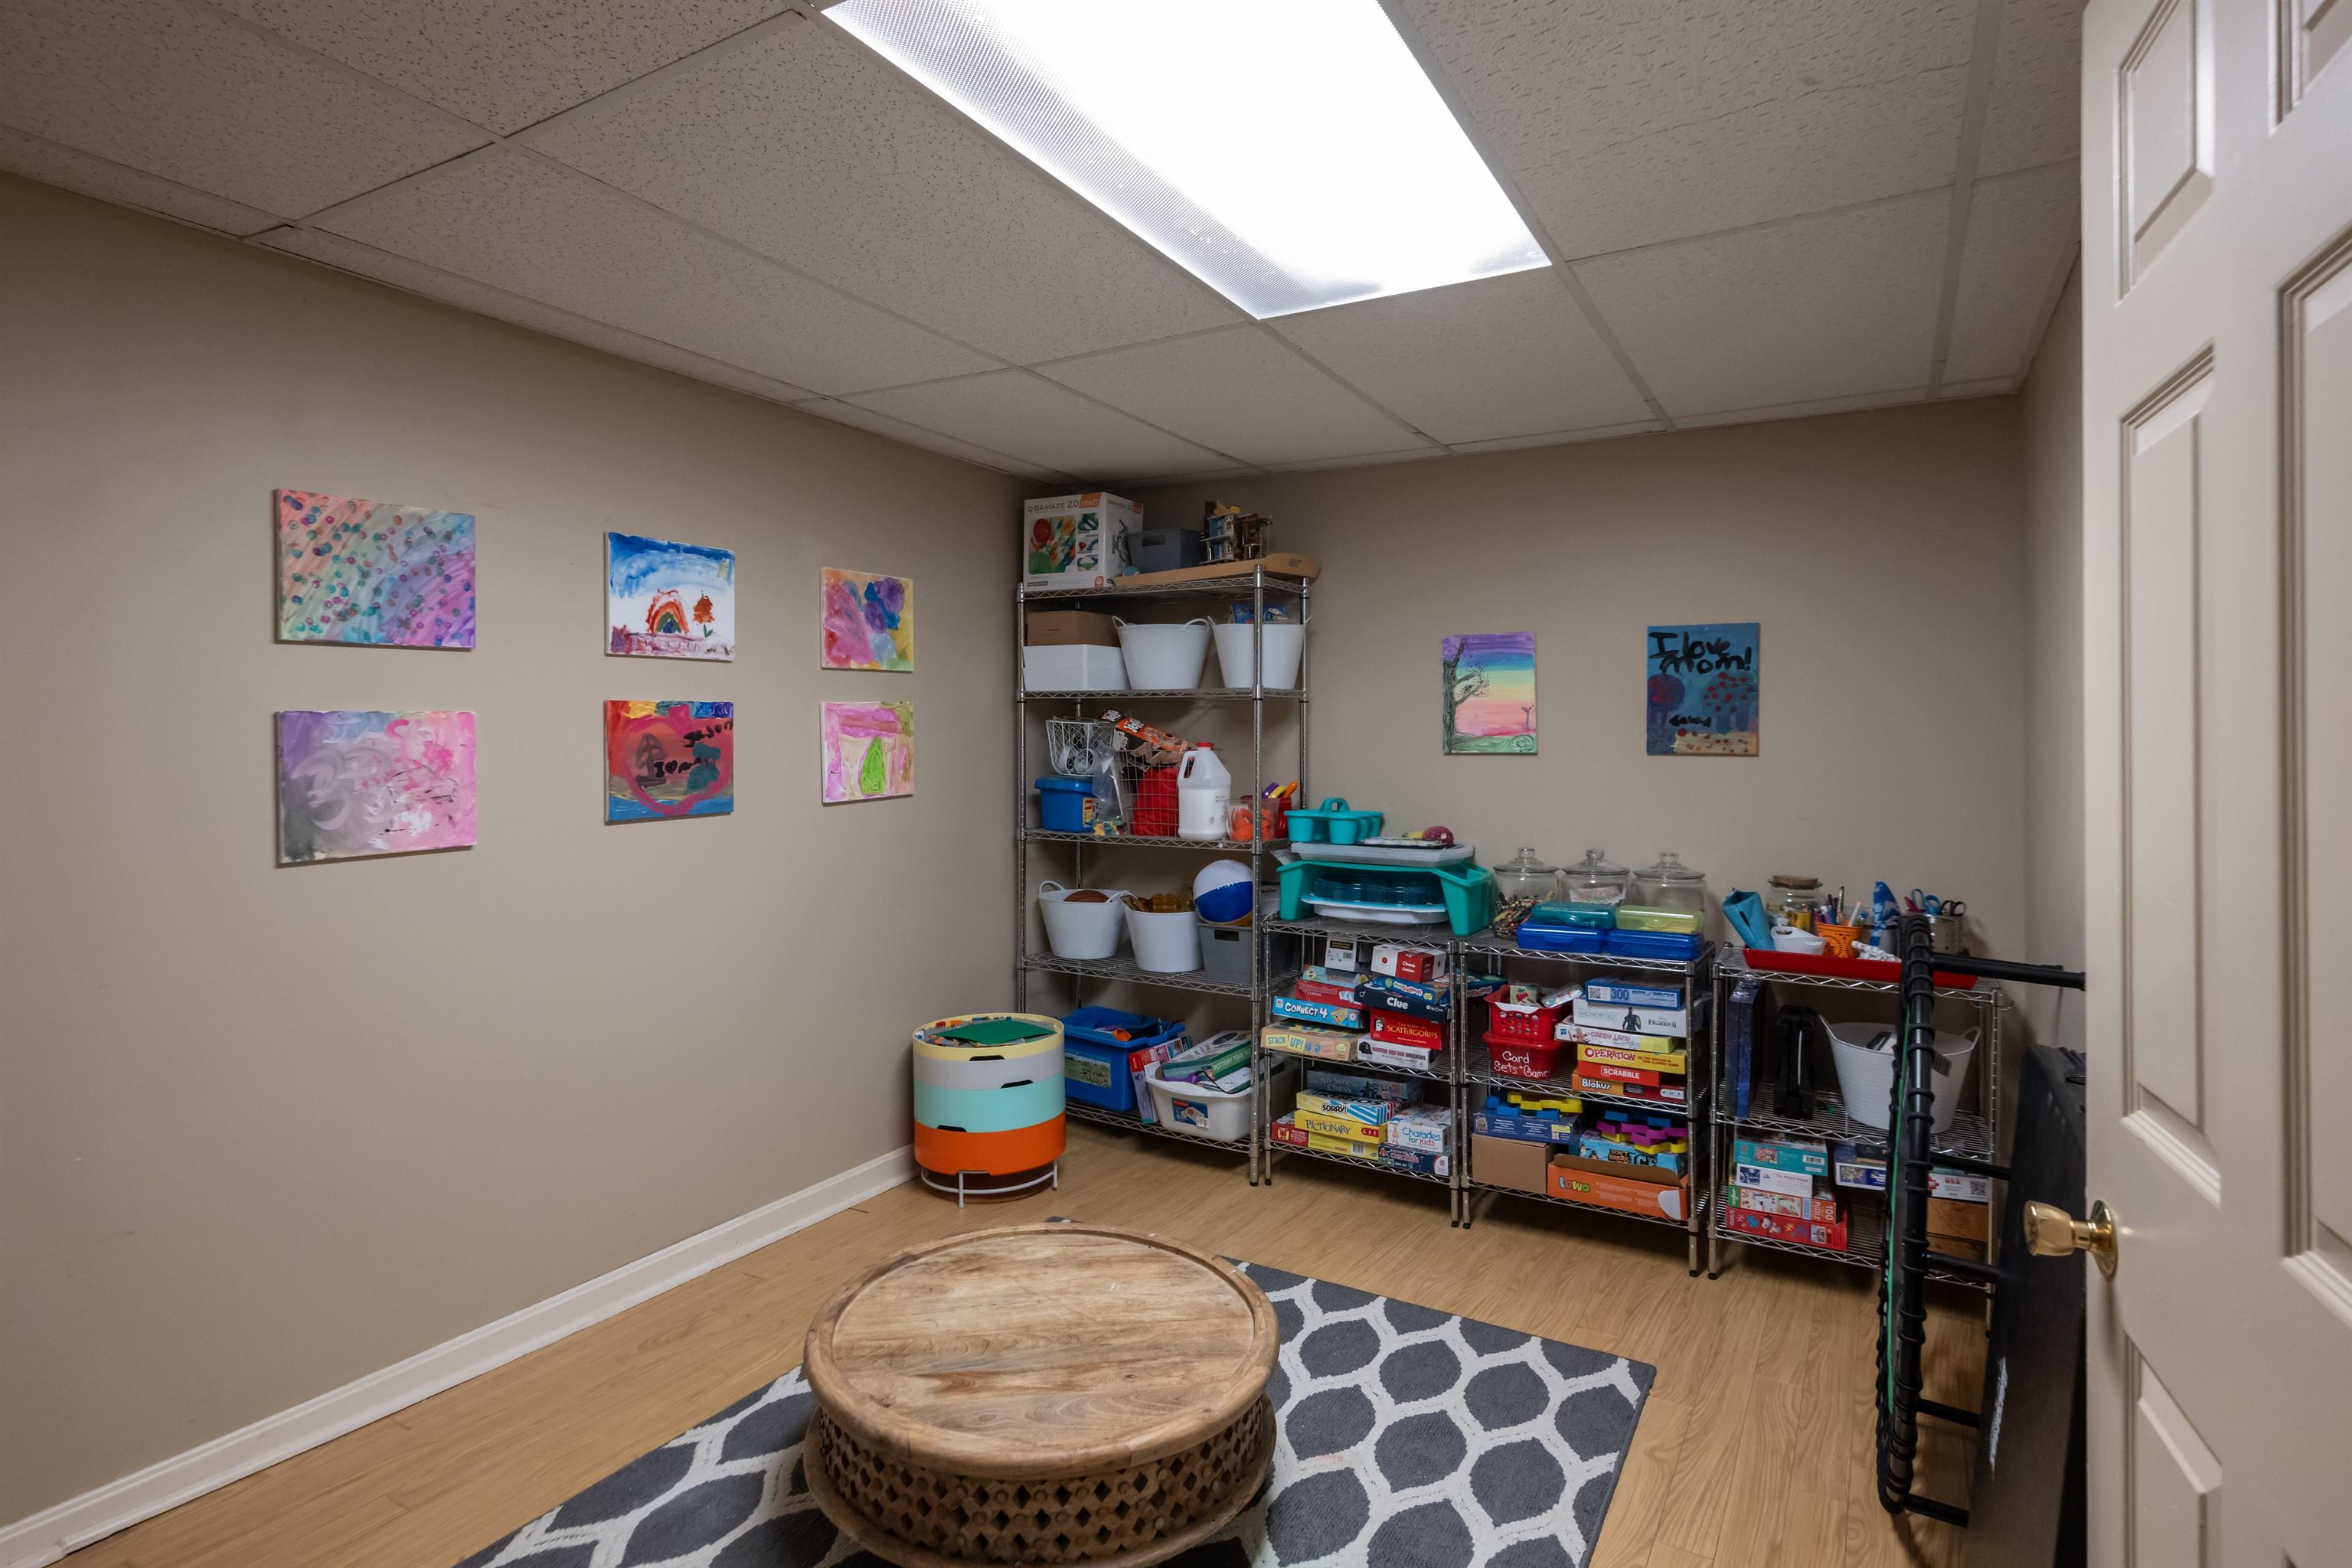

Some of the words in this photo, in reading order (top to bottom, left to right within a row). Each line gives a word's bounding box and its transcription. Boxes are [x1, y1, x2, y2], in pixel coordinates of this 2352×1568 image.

[1067, 500, 1079, 508] 2.0
[1648, 632, 1680, 658] I
[1683, 631, 1730, 659] love
[1611, 988, 1629, 1000] 300
[1387, 997, 1409, 1009] Clue
[1285, 1002, 1318, 1016] CONNECT
[1319, 1007, 1328, 1019] 4
[1579, 1010, 1616, 1020] MONOPOLY
[1267, 1036, 1286, 1045] STACK
[1289, 1037, 1304, 1050] UP!
[1590, 1031, 1612, 1040] CANDY
[1613, 1034, 1631, 1042] LAND
[1502, 1051, 1530, 1064] Card
[1584, 1047, 1635, 1062] OPERATION
[1214, 1057, 1233, 1070] POTTERY
[1494, 1061, 1517, 1074] Sets
[1602, 1067, 1640, 1079] SCRABBLE
[1327, 1084, 1351, 1093] Chess
[1333, 1077, 1360, 1087] Stress
[1581, 1077, 1611, 1090] Blokus
[1322, 1104, 1348, 1113] SORRY!
[1305, 1119, 1351, 1135] PICTIONARY
[1402, 1127, 1441, 1142] Charades
[1409, 1135, 1418, 1144] for
[1419, 1138, 1435, 1147] Kids
[1824, 1204, 1834, 1220] 100
